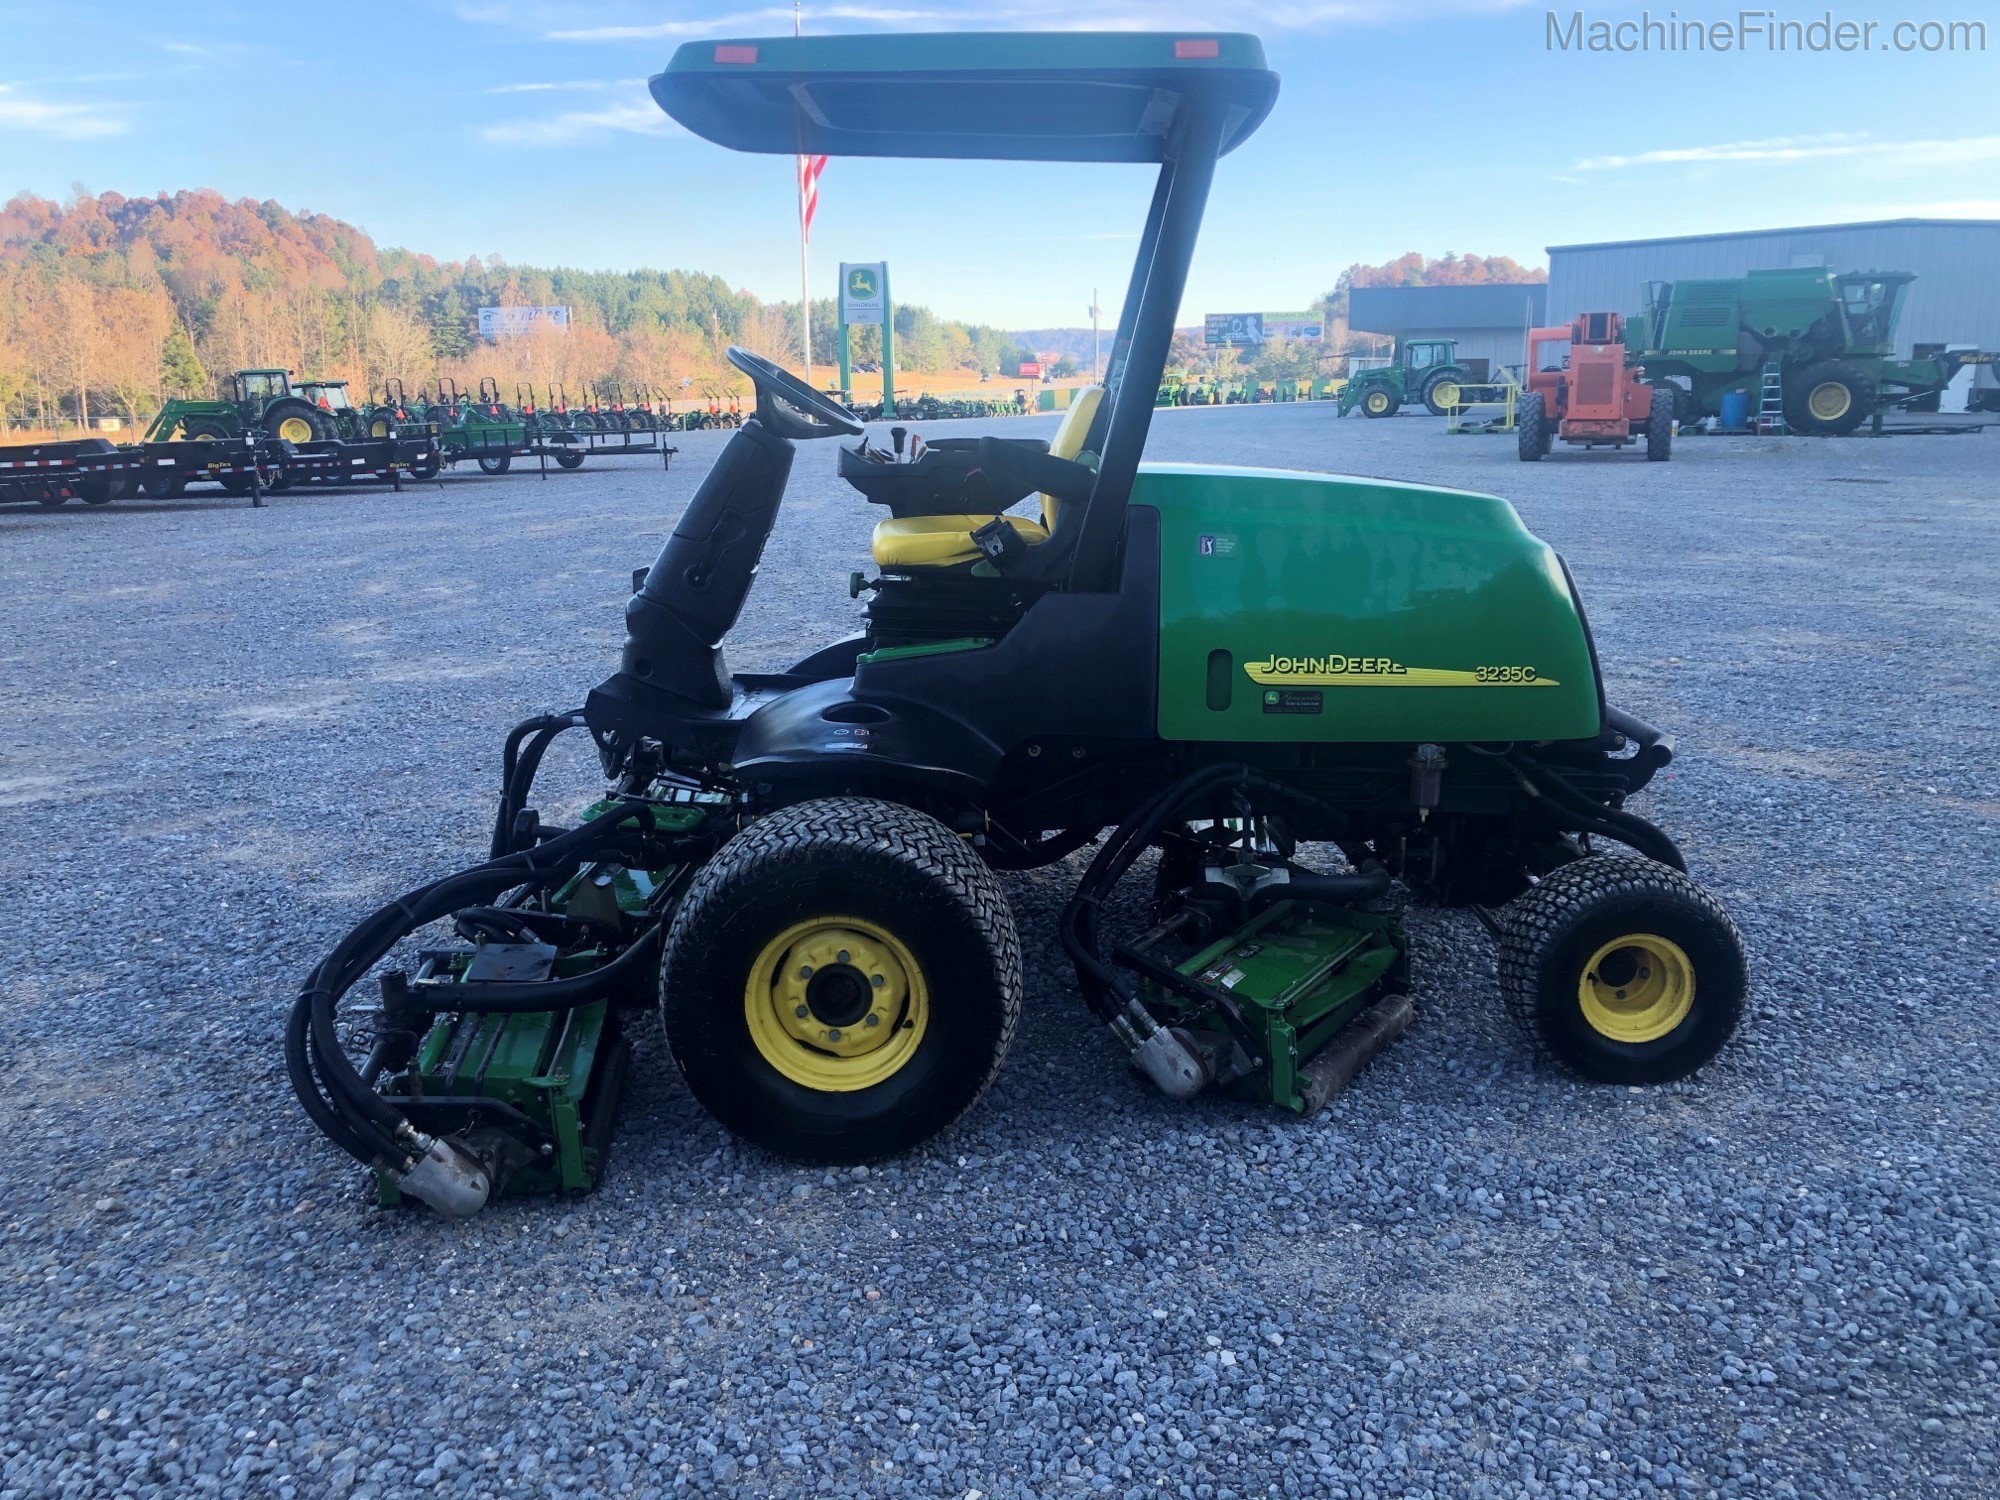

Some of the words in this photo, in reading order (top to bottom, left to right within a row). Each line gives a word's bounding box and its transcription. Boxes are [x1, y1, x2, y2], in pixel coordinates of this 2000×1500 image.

[1261, 653, 1326, 674] JOHN
[1328, 654, 1407, 675] DEERE
[1475, 665, 1536, 682] 3235C
